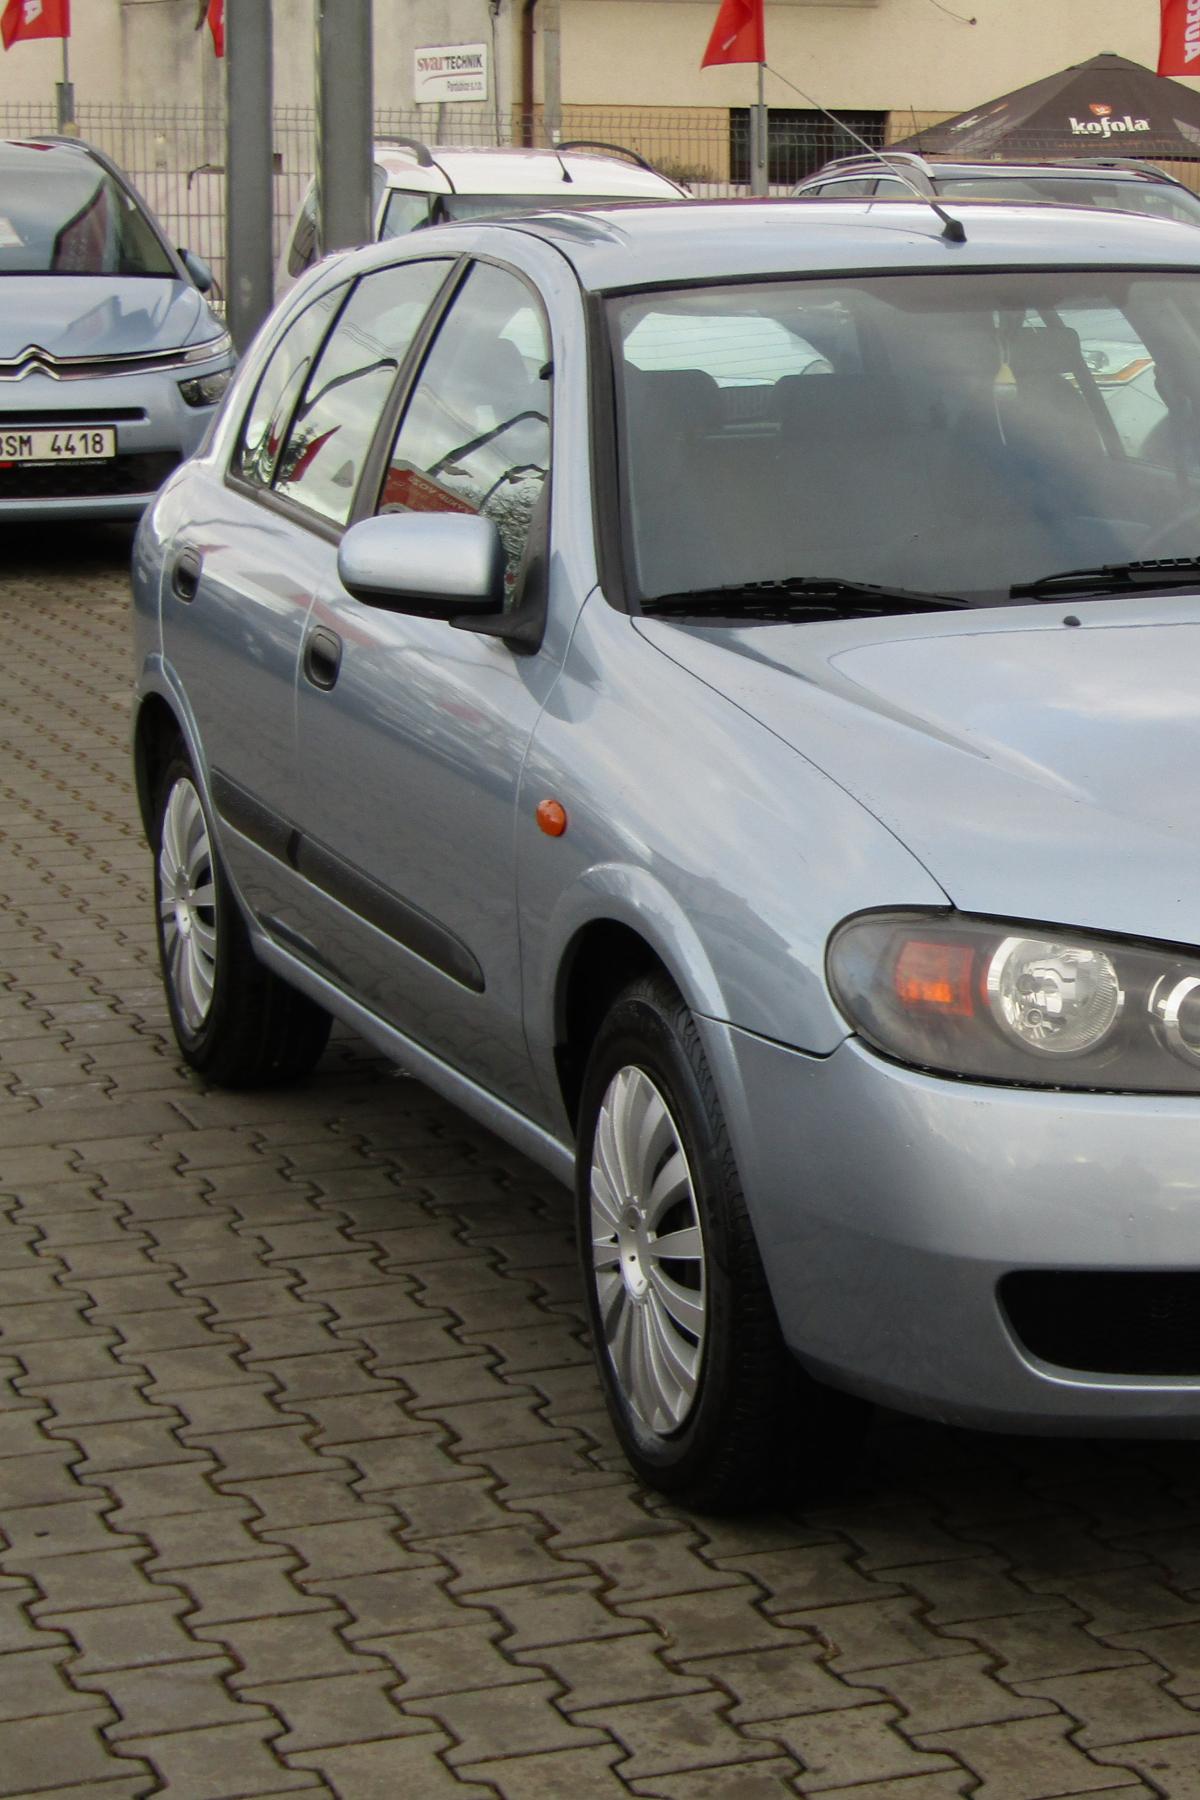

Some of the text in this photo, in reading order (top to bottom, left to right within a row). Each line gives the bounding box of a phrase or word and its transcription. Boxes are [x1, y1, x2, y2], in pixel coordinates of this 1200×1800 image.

[1069, 116, 1150, 138] kofola
[0, 432, 104, 457] SM 4418
